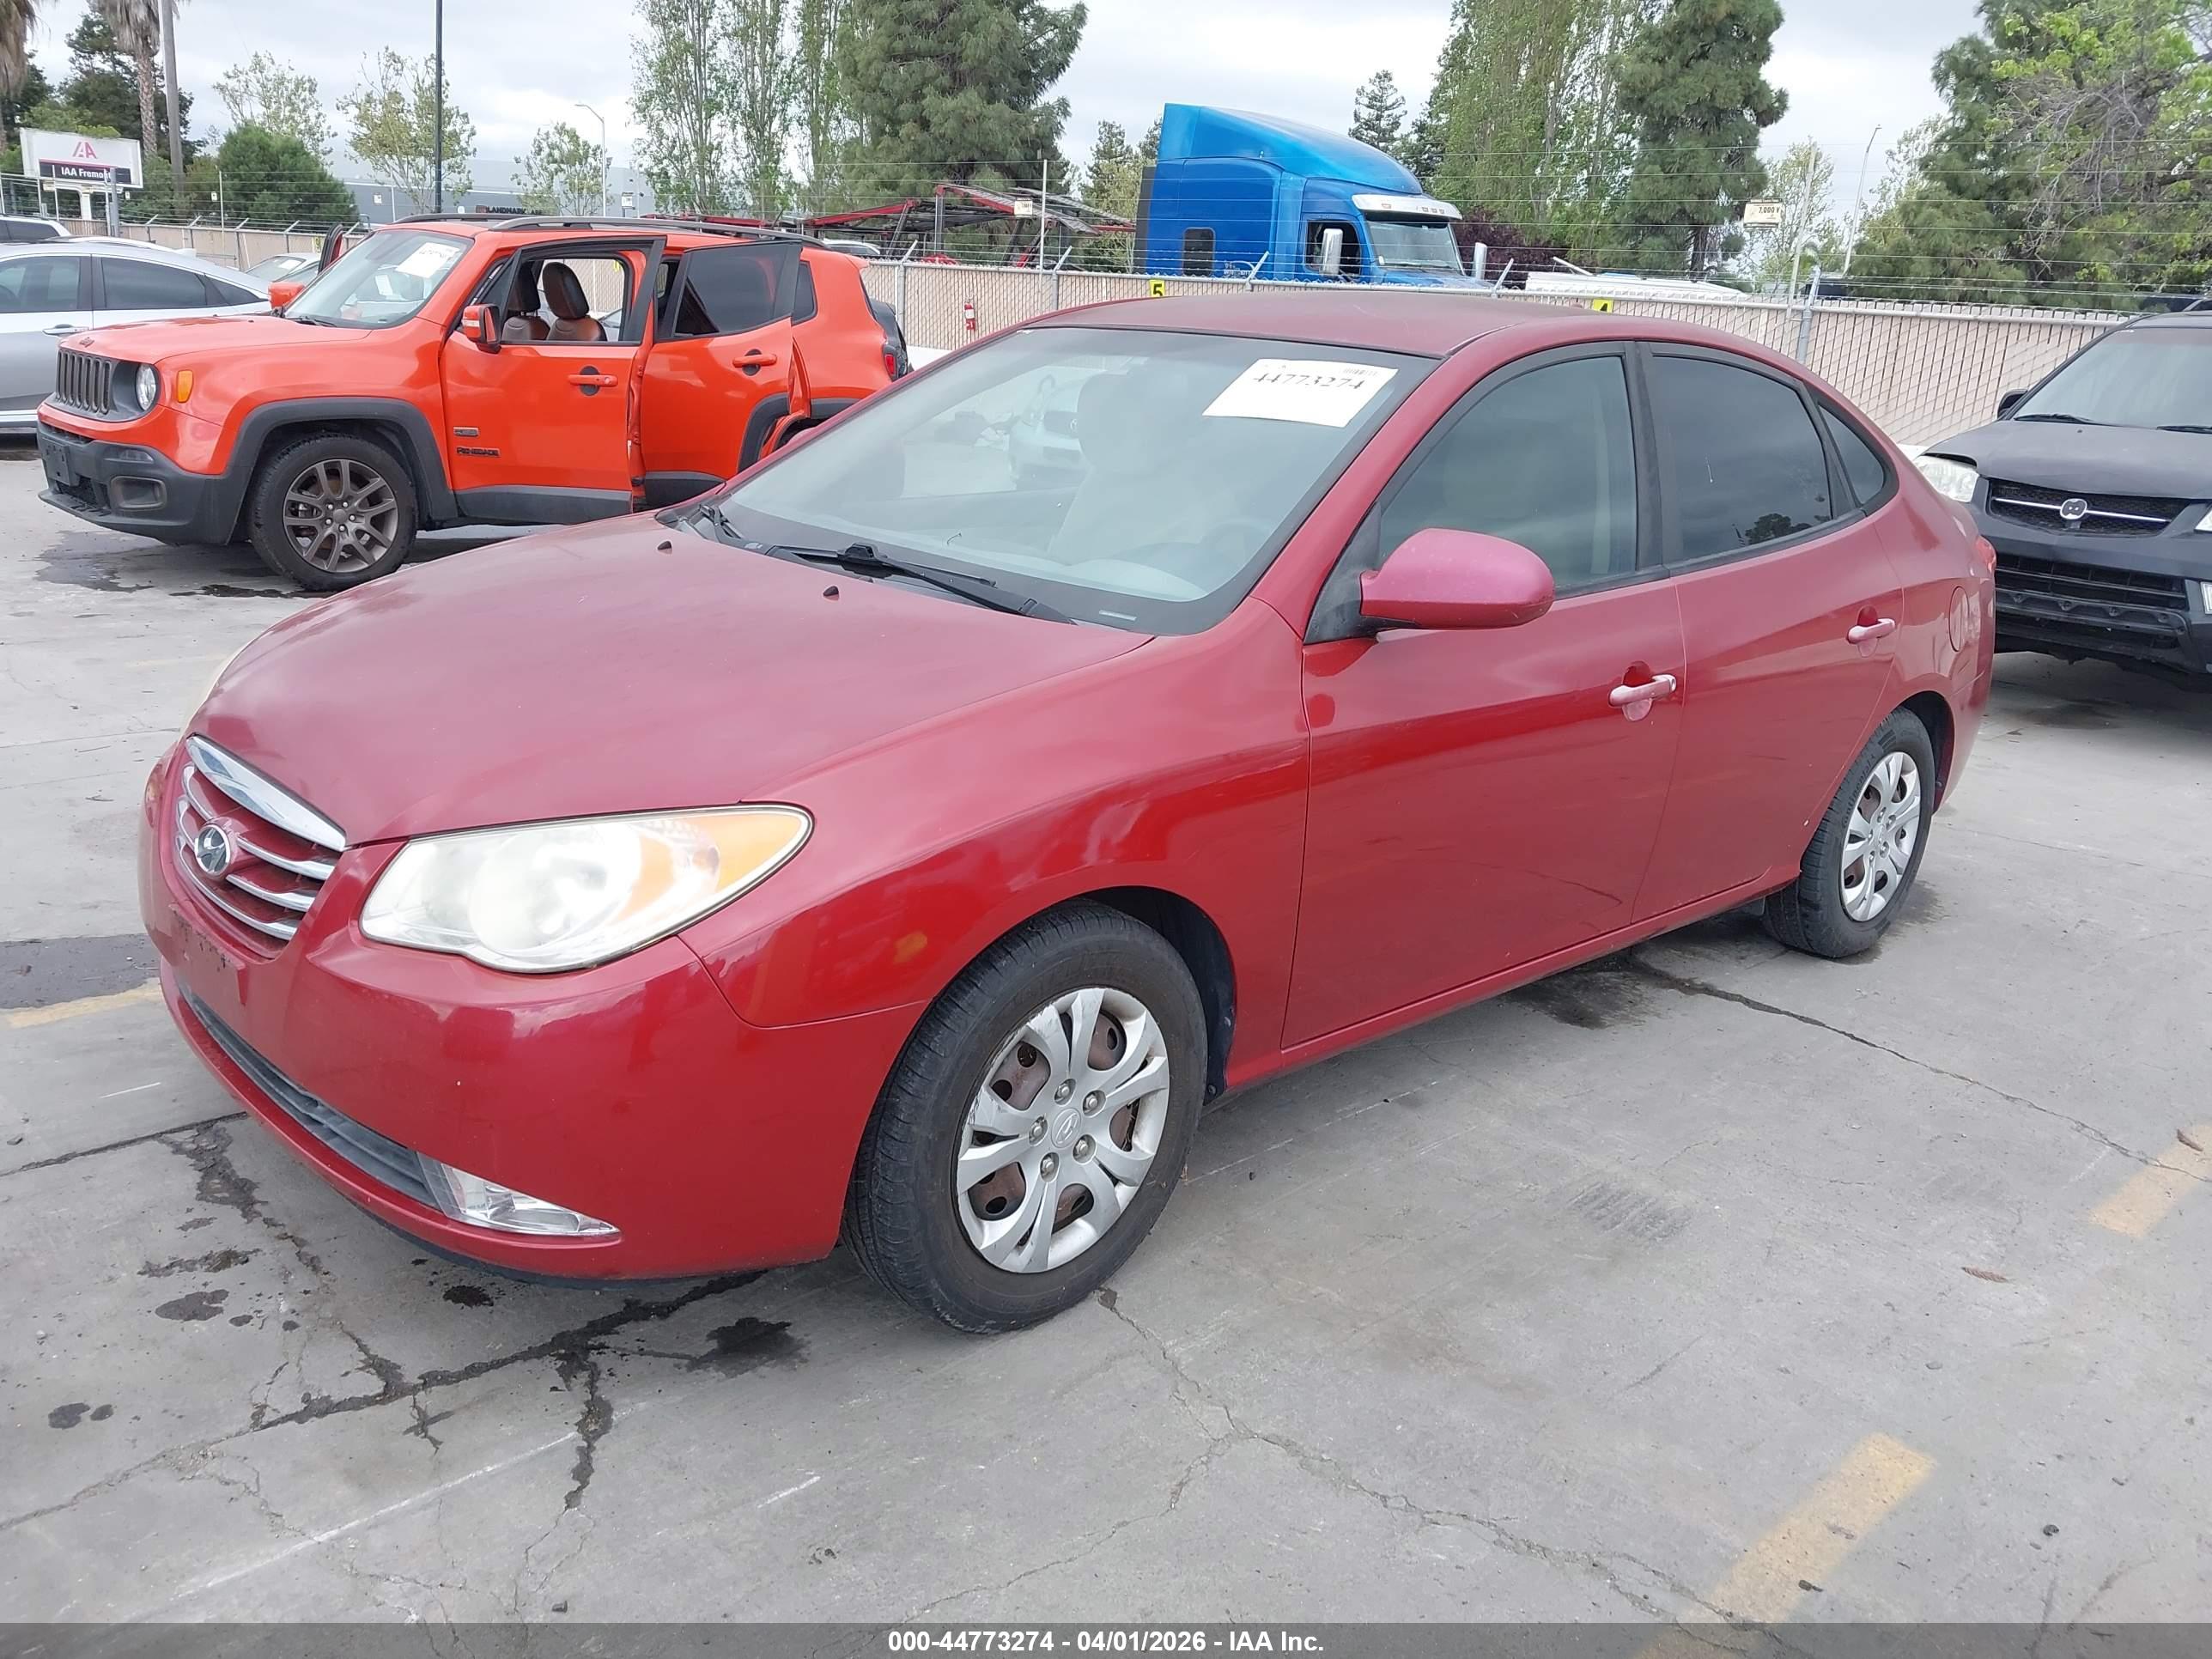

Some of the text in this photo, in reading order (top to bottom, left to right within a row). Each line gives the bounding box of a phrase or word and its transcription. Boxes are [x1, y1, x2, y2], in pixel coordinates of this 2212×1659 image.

[61, 167, 77, 177] IAA
[1153, 283, 1164, 296] 5
[1253, 373, 1366, 389] 44773274
